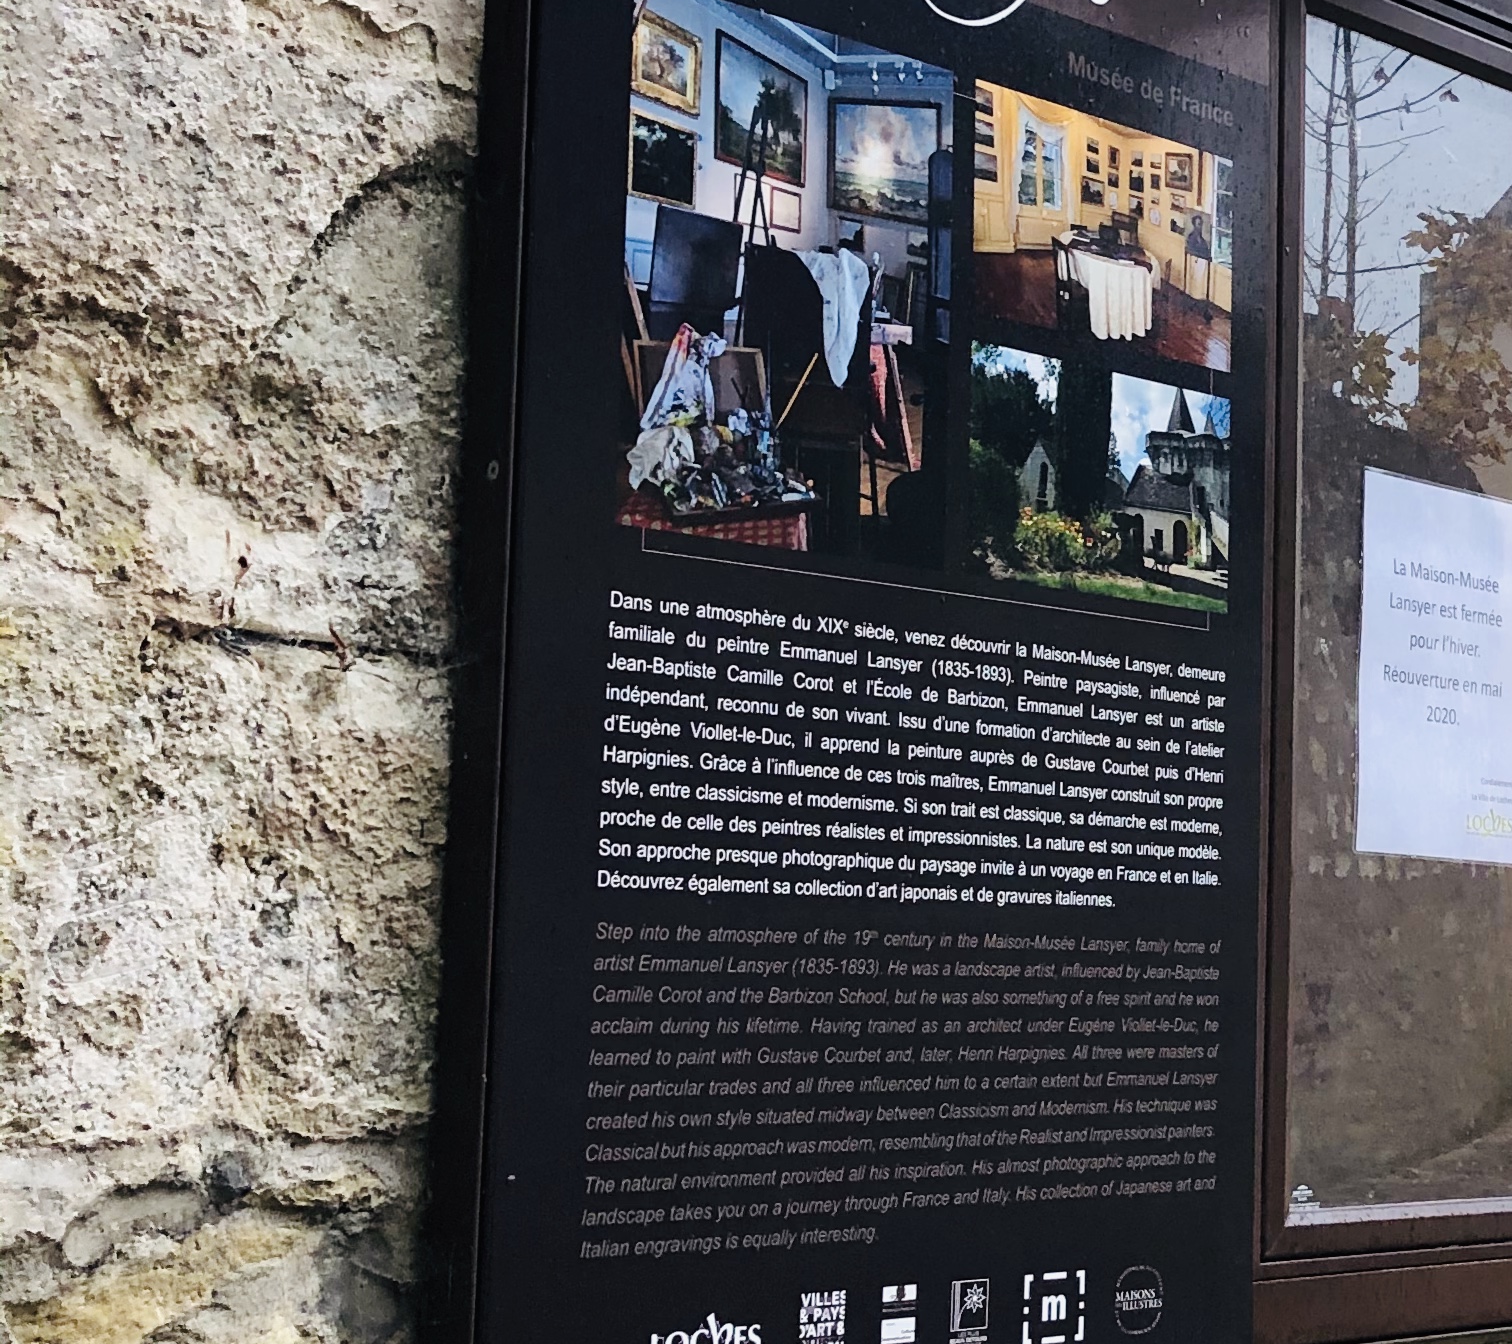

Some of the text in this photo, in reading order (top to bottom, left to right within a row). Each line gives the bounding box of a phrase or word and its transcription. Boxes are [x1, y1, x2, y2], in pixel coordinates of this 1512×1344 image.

[1068, 51, 1234, 127] Musée de France
[1394, 558, 1499, 594] La Maison-Musée
[610, 590, 653, 612] Dans
[659, 600, 689, 616] une
[695, 602, 786, 628] atmosphère
[792, 613, 811, 631] du
[854, 621, 898, 644] siècle,
[904, 630, 945, 647] venez
[950, 633, 1011, 655] découvrir
[1015, 641, 1027, 657] la
[1032, 643, 1120, 669] Maison-Musée
[1125, 655, 1173, 677] Lansyer,
[1177, 662, 1226, 682] demeure
[1390, 592, 1502, 628] Lansyer est fermée
[608, 620, 1226, 709] familiale du peintre Emmanuel Lansyer (1835-1893). Peintre paysagiste, influencé par
[1410, 634, 1439, 651] pour
[606, 652, 716, 680] Jean-Baptiste
[726, 664, 783, 687] Camille
[793, 671, 834, 692] Corot
[842, 678, 857, 694] et
[920, 685, 939, 703] de
[947, 688, 1008, 712] Barbizon,
[1017, 695, 1083, 717] Emmanuel
[1090, 704, 1138, 726] Lansyer
[1144, 712, 1163, 726] est
[1169, 716, 1184, 728] un
[1191, 716, 1225, 733] artiste
[1383, 664, 1502, 698] Réouverture en mai
[605, 682, 709, 711] indépendant,
[717, 697, 778, 715] reconnu
[785, 700, 805, 718] de
[811, 706, 838, 721] son
[845, 706, 891, 726] vivant.
[898, 711, 926, 729] Issu
[975, 718, 1035, 740] formation
[1115, 736, 1131, 749] au
[1136, 736, 1161, 751] sein
[1165, 738, 1180, 754] de
[1427, 705, 1460, 726] 2020.
[603, 744, 693, 770] Harpignies.
[699, 752, 747, 772] Grâce
[751, 756, 761, 773] à
[844, 764, 863, 781] de
[867, 769, 892, 784] ces
[896, 769, 926, 786] trois
[930, 772, 983, 792] maîtres,
[988, 775, 1056, 796] Emmanuel
[1059, 781, 1108, 802] Lansyer
[1110, 788, 1160, 804] construit
[1163, 793, 1184, 806] son
[1187, 795, 1223, 811] propre
[690, 721, 795, 749] Viollet-le-Duc,
[804, 731, 812, 748] il
[820, 736, 879, 754] apprend
[887, 738, 900, 755] la
[907, 742, 962, 761] peinture
[969, 748, 1014, 767] auprès
[1021, 751, 1038, 767] de
[1044, 752, 1095, 772] Gustave
[1102, 758, 1149, 777] Courbet
[1154, 764, 1179, 781] puis
[599, 809, 1221, 860] proche de celle des peintres réalistes et impressionnistes. La nature est son unique modèle.
[601, 777, 1222, 836] style, entre classicisme et modernisme. Si son trait est classique, sa démarche est moderne,
[813, 1306, 845, 1322] PAYS
